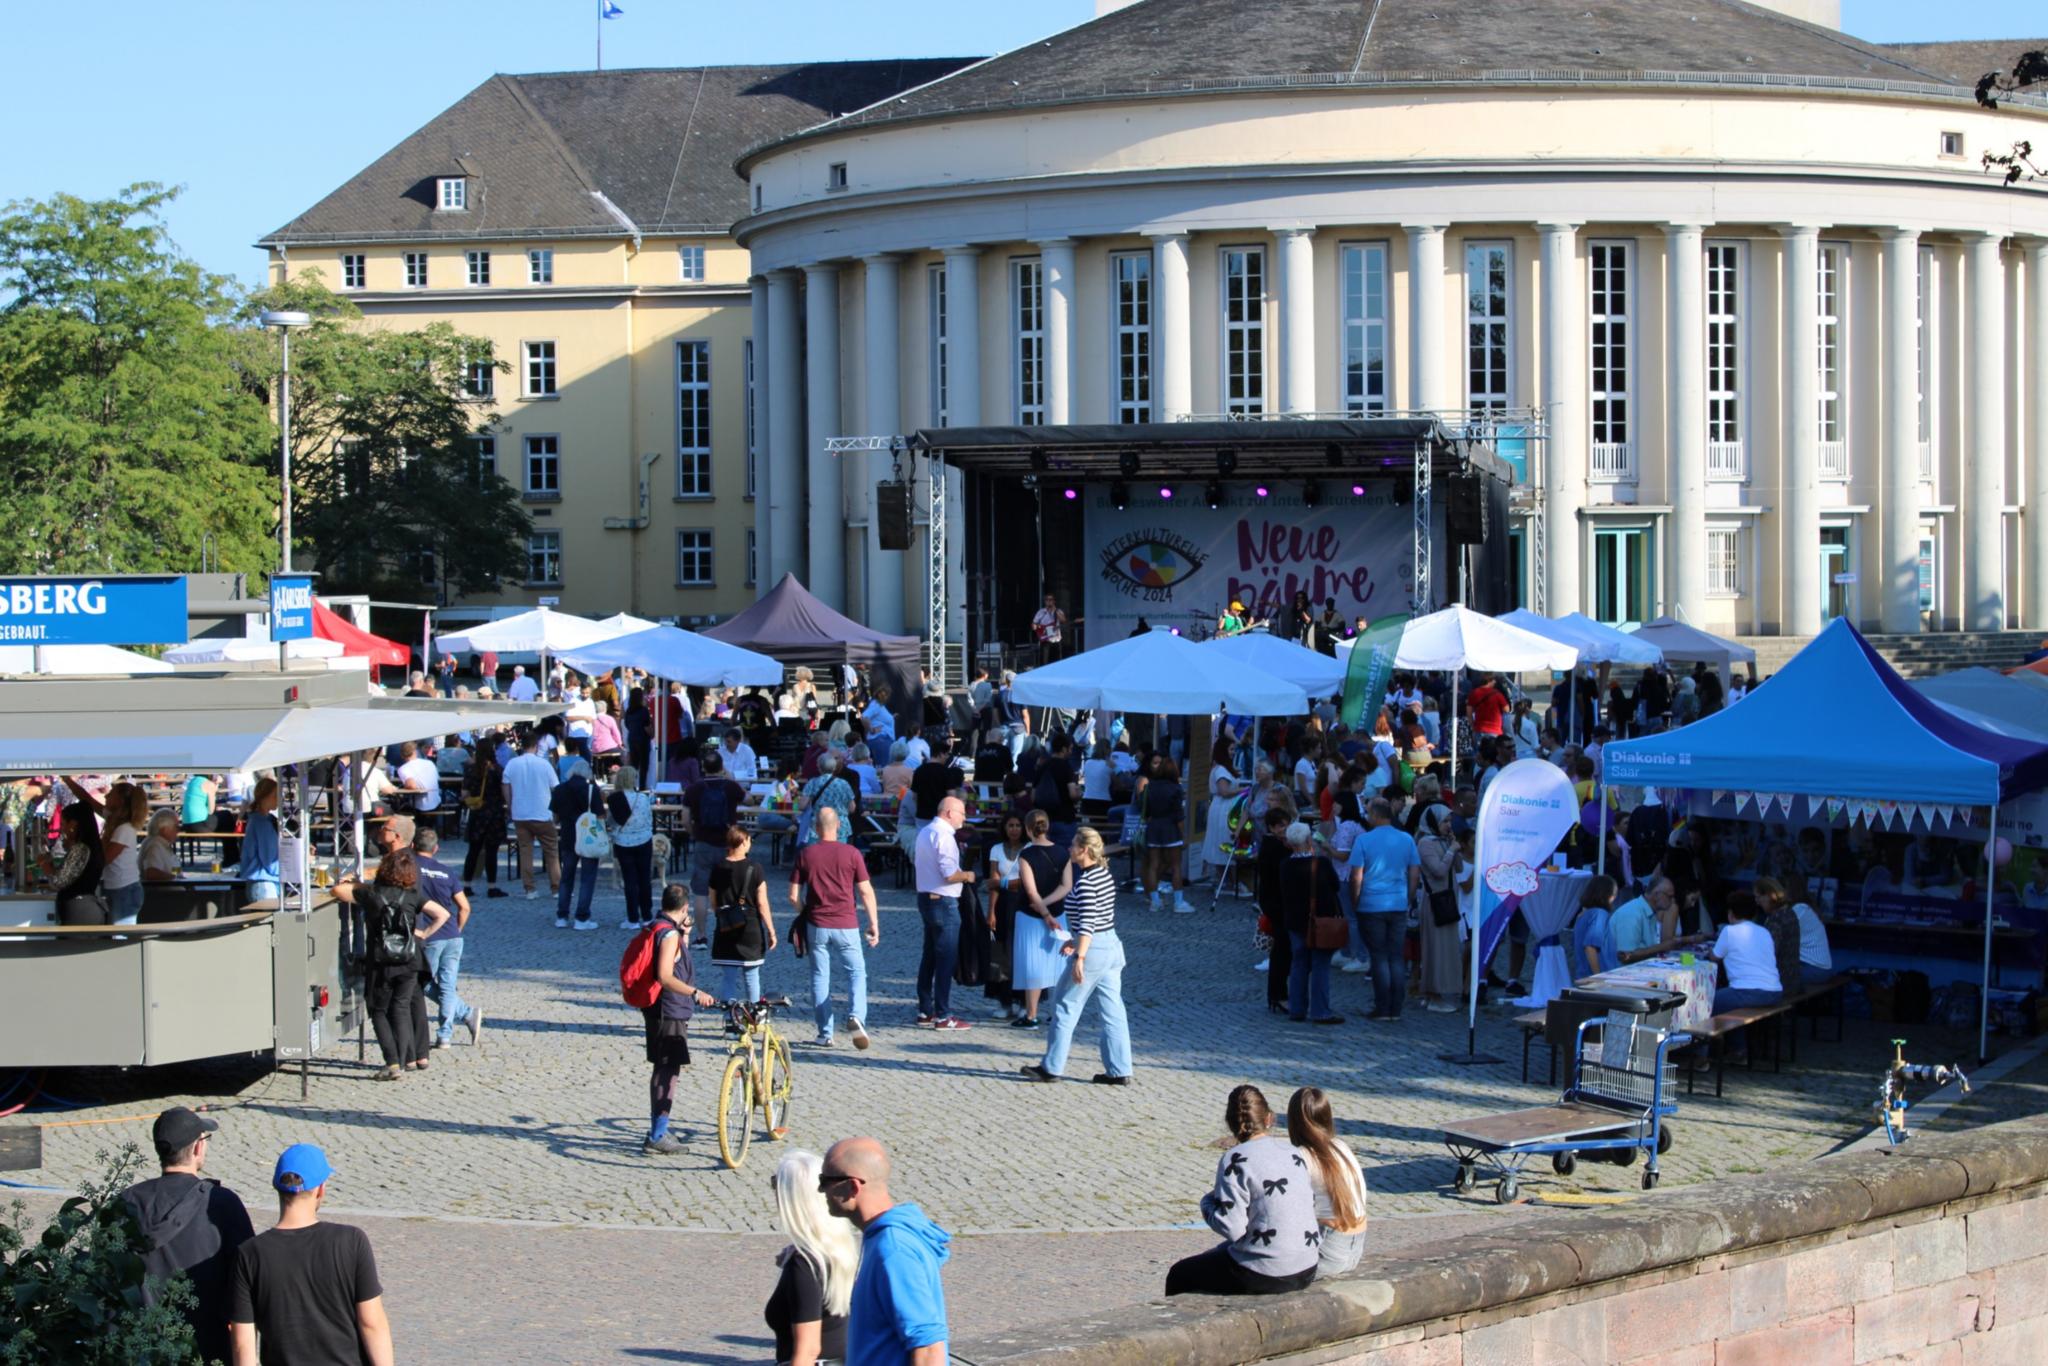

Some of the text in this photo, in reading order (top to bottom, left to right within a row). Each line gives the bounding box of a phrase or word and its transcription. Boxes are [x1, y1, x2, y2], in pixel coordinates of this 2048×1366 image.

[1099, 528, 1209, 566] INTERKULTURELLE
[1238, 520, 1340, 571] Neue
[1101, 569, 1172, 603] WOCHE 2024
[1611, 751, 1676, 765] Diakonie
[1611, 765, 1640, 777] Saar
[1501, 794, 1549, 808] Diakonie
[1500, 806, 1521, 817] Saar
